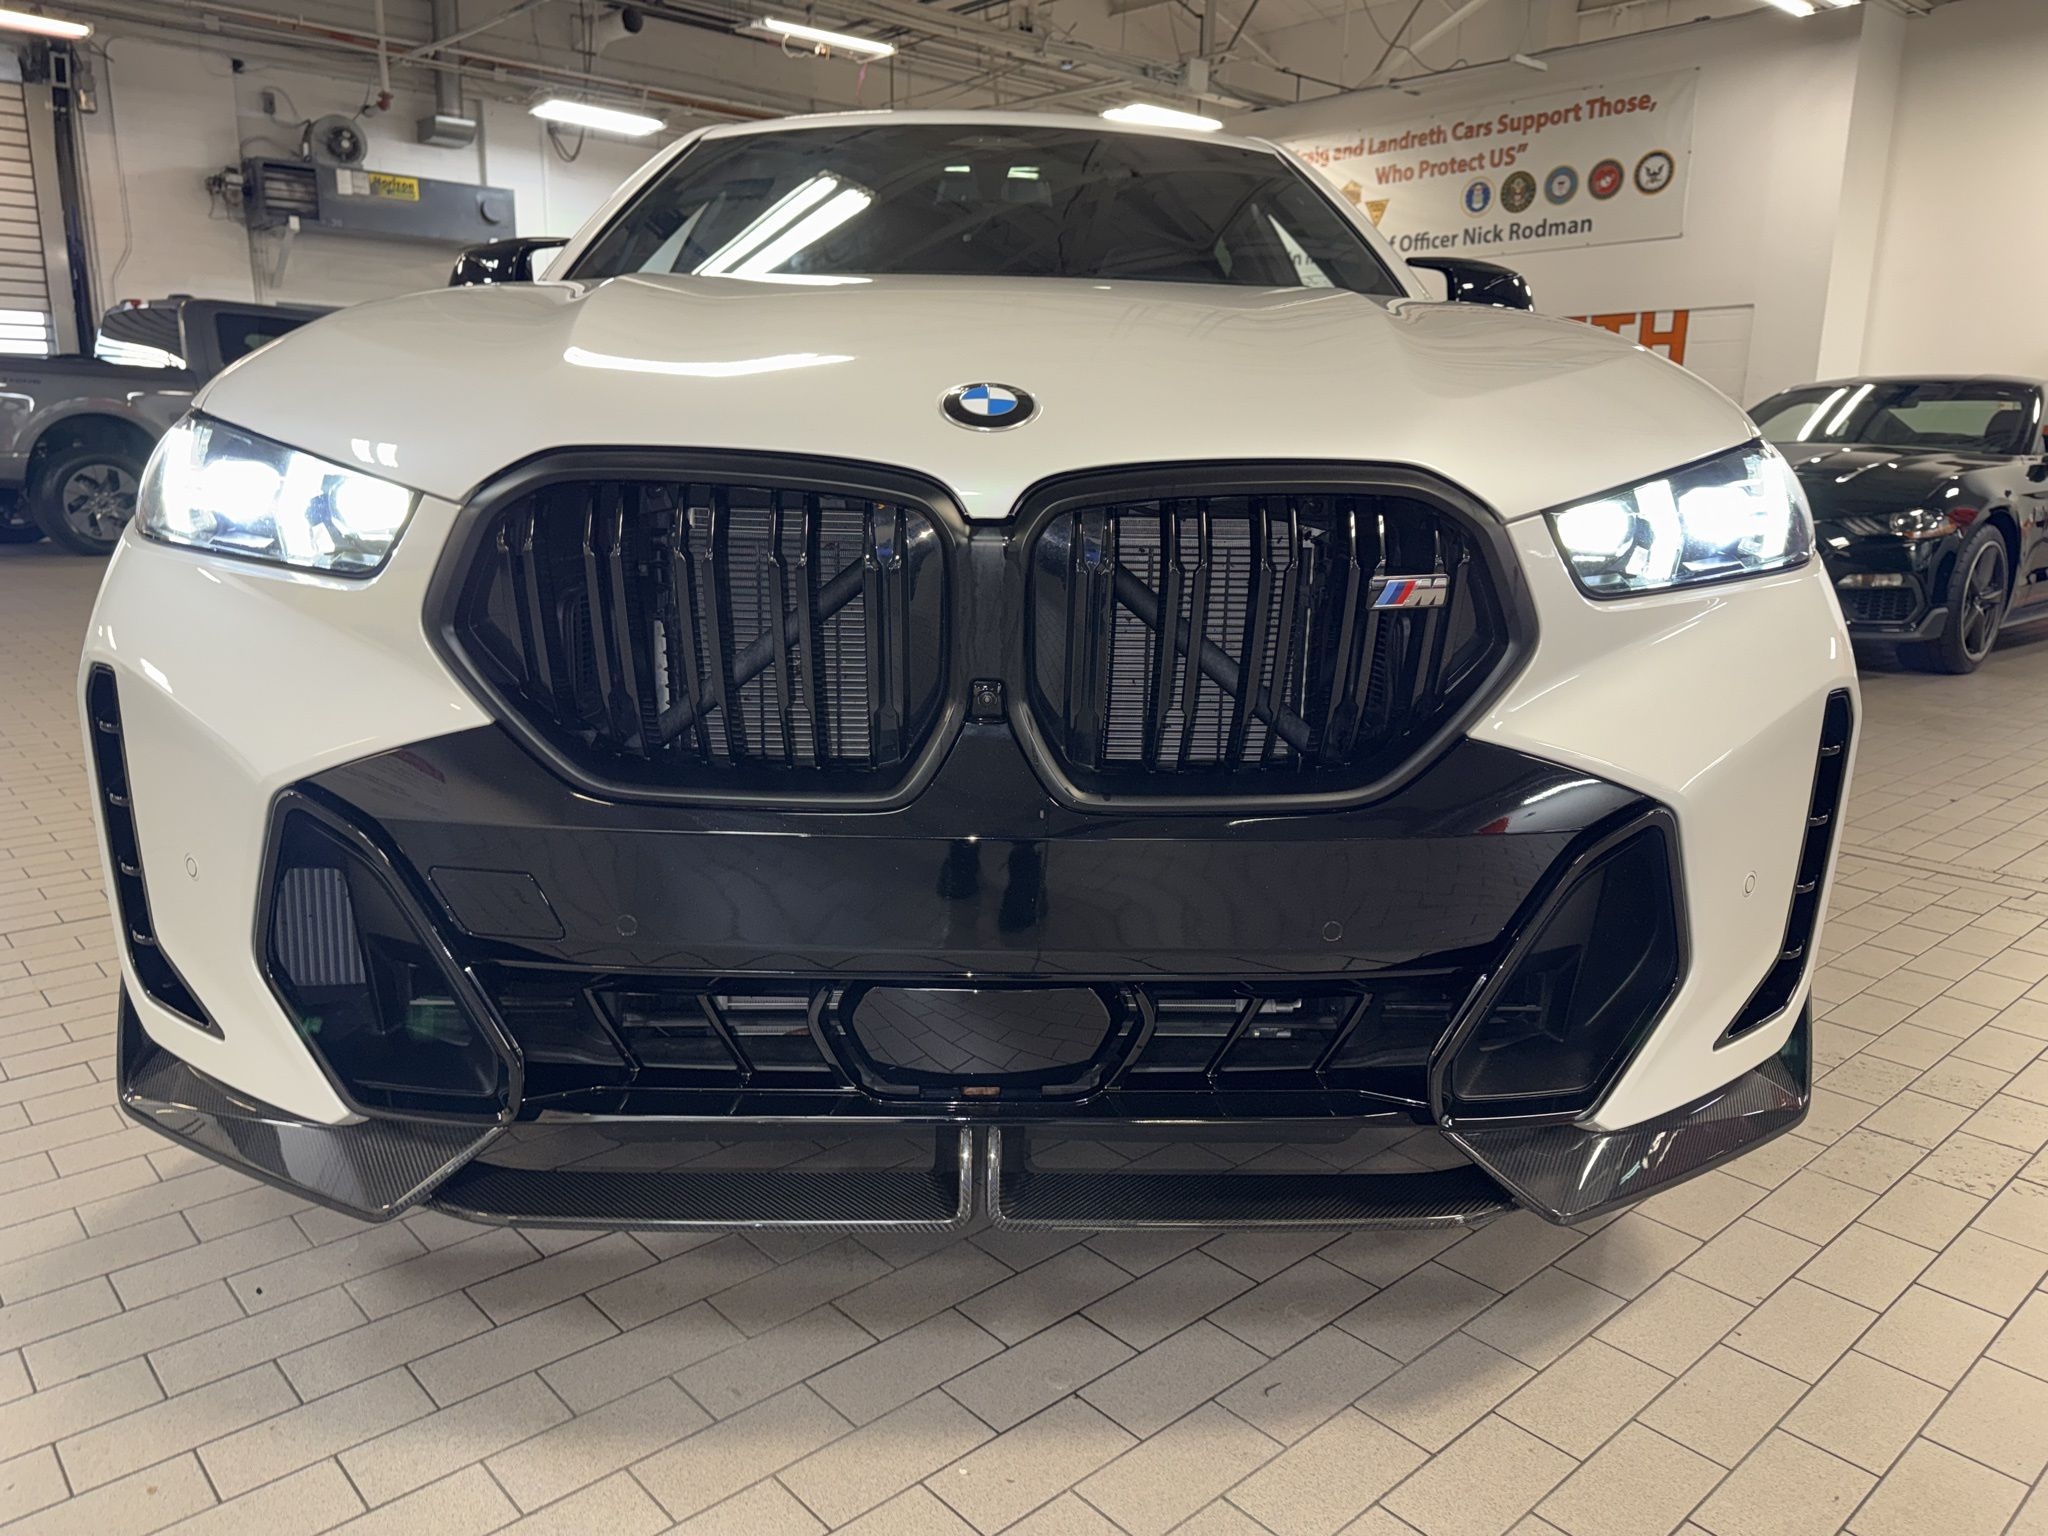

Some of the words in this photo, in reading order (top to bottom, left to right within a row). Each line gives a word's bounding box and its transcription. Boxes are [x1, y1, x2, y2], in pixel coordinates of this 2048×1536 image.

[1333, 139, 1364, 160] and
[1368, 124, 1447, 155] Landreth
[1452, 119, 1493, 142] Cars
[1497, 102, 1582, 135] Support
[1585, 94, 1657, 120] Those,
[1375, 164, 1415, 185] Who
[1418, 149, 1485, 180] Protect
[1399, 230, 1459, 252] Officer
[1462, 223, 1504, 247] Nick
[1508, 217, 1594, 243] Rodman
